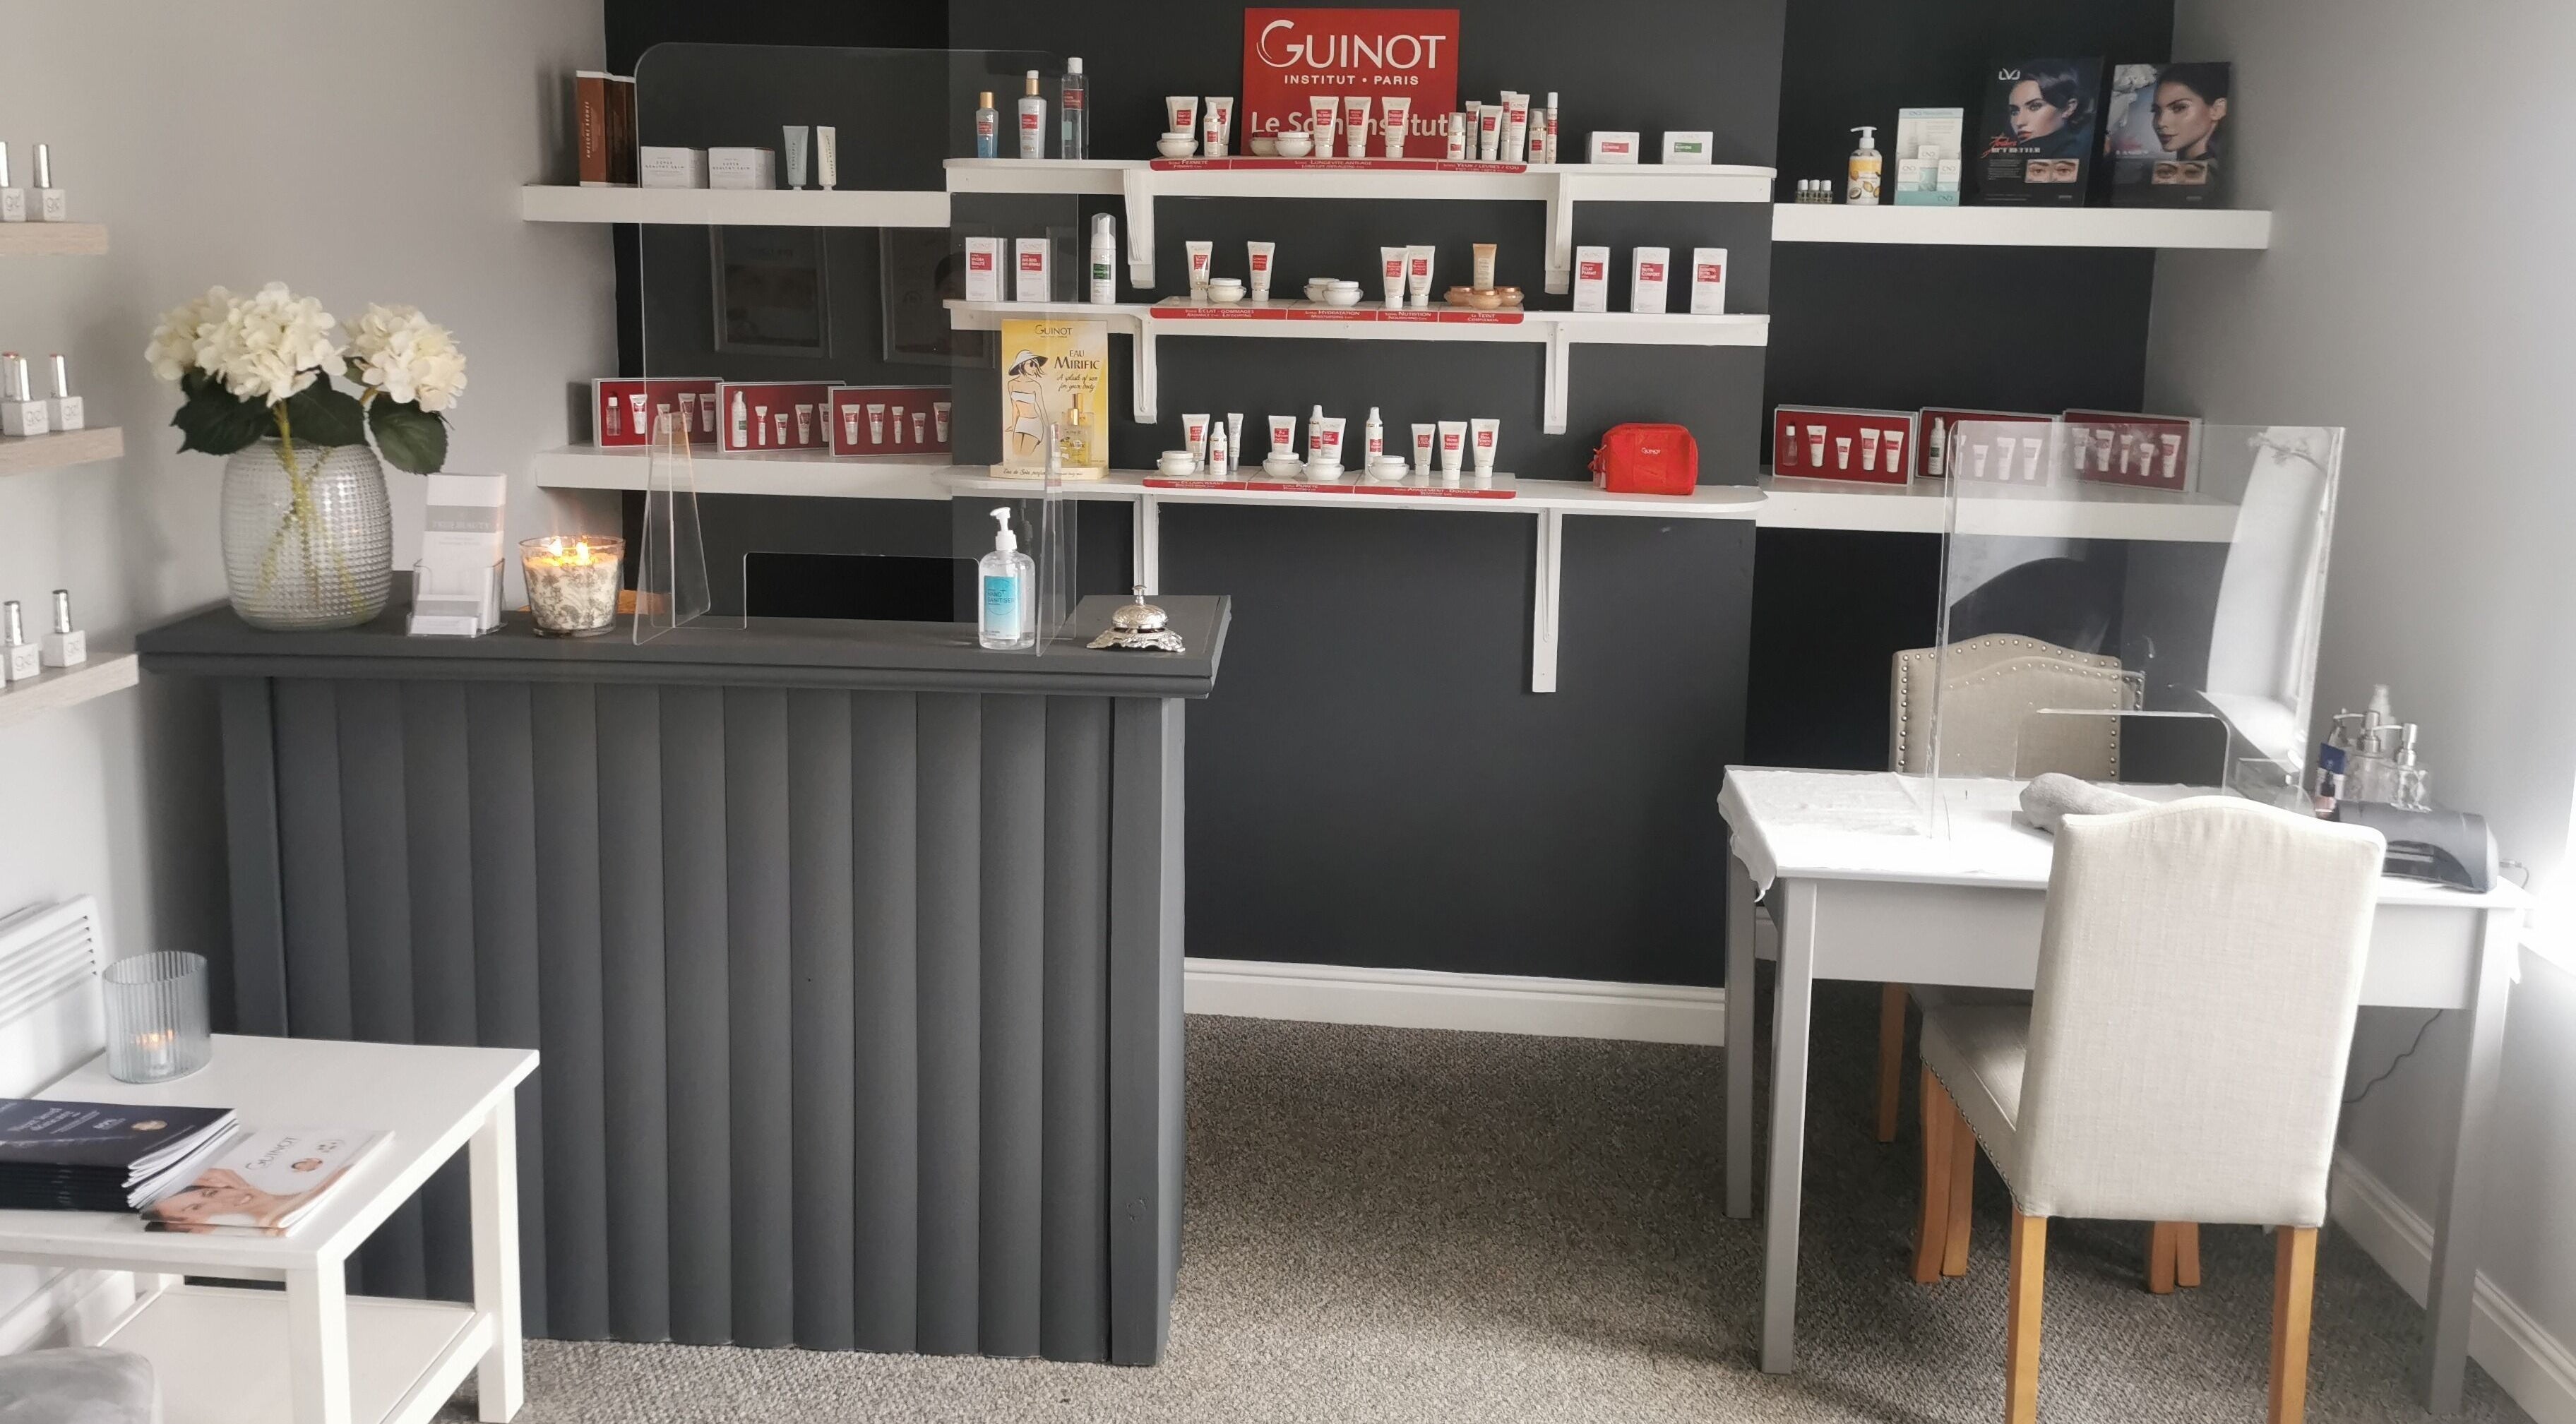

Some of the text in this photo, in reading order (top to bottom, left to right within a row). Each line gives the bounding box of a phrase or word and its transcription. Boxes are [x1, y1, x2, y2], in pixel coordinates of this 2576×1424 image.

[1257, 19, 1446, 68] GUINOT
[1284, 74, 1419, 85] INSTITUT PARIS
[1251, 112, 1280, 133] Le
[1289, 112, 1344, 135] Son
[1035, 324, 1073, 335] GUINOT
[1054, 357, 1100, 369] MIRIFIC
